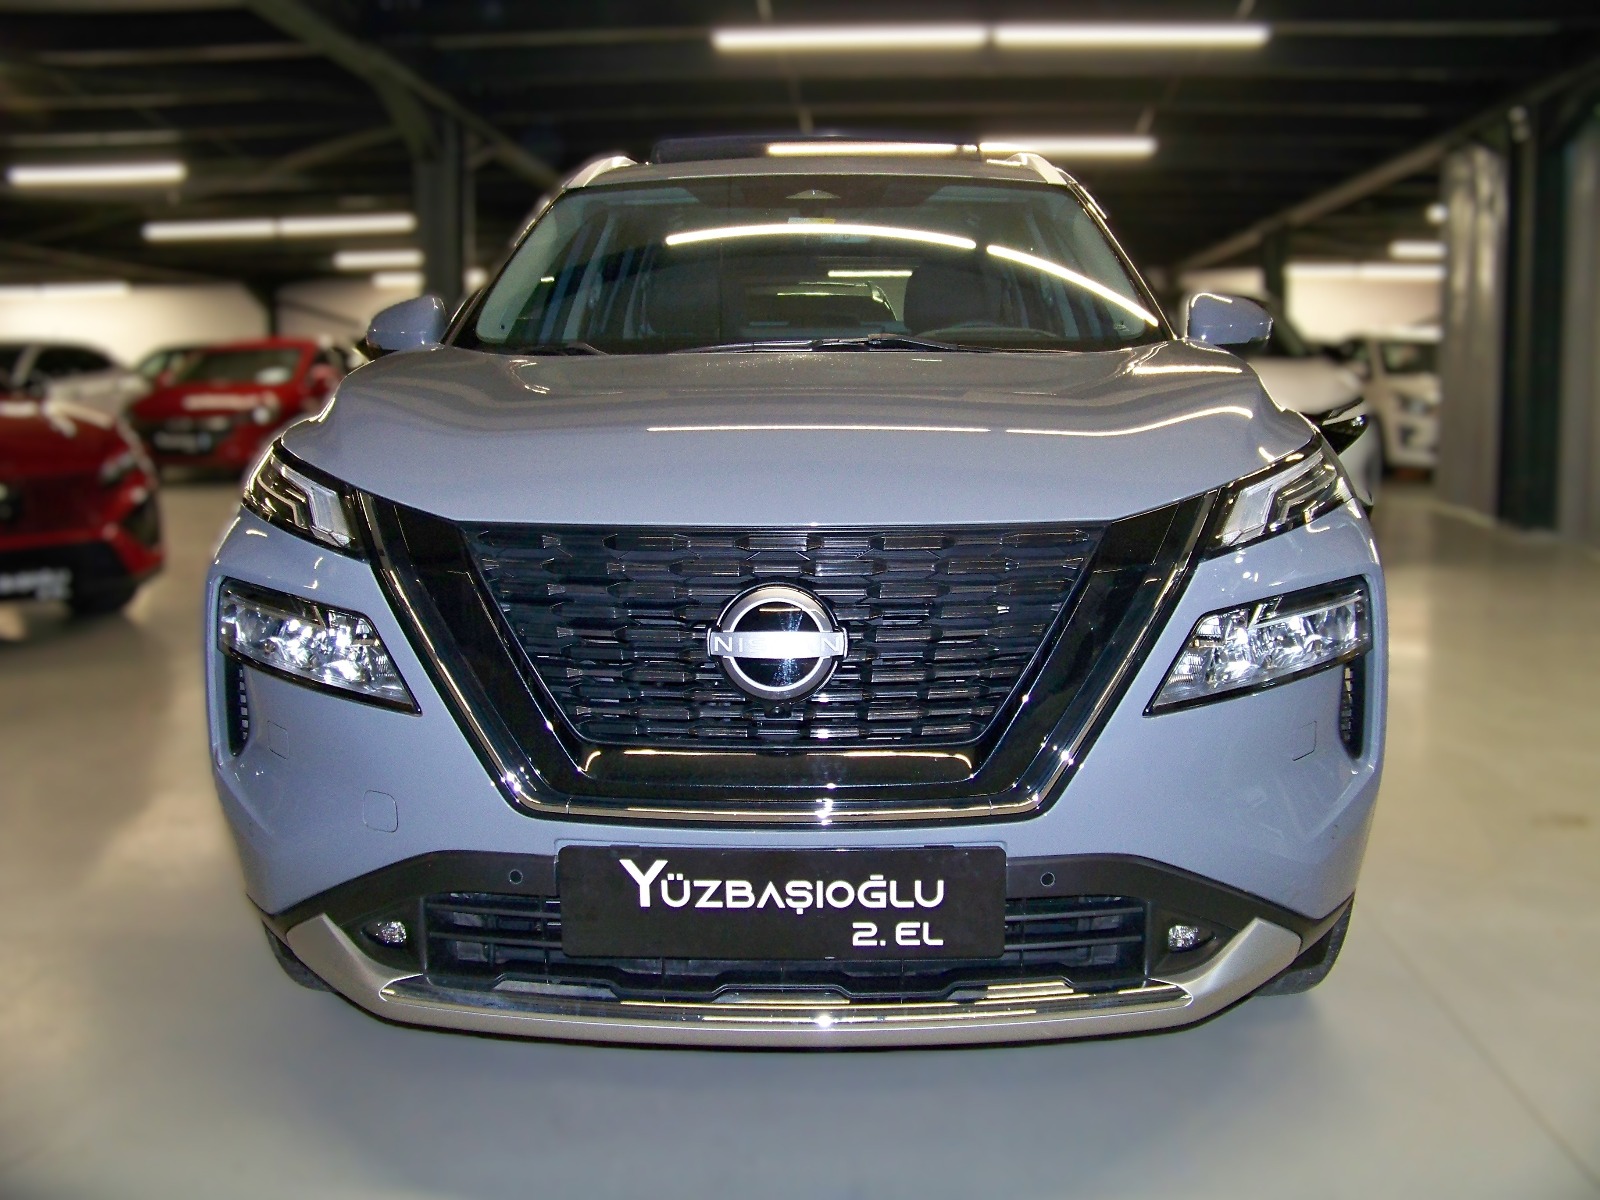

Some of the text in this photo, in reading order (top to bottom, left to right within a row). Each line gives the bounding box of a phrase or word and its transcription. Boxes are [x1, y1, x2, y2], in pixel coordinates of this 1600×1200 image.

[714, 636, 840, 654] NISN
[619, 858, 945, 915] YÜZBAŞIOĞLU
[852, 921, 944, 947] 2. EL
